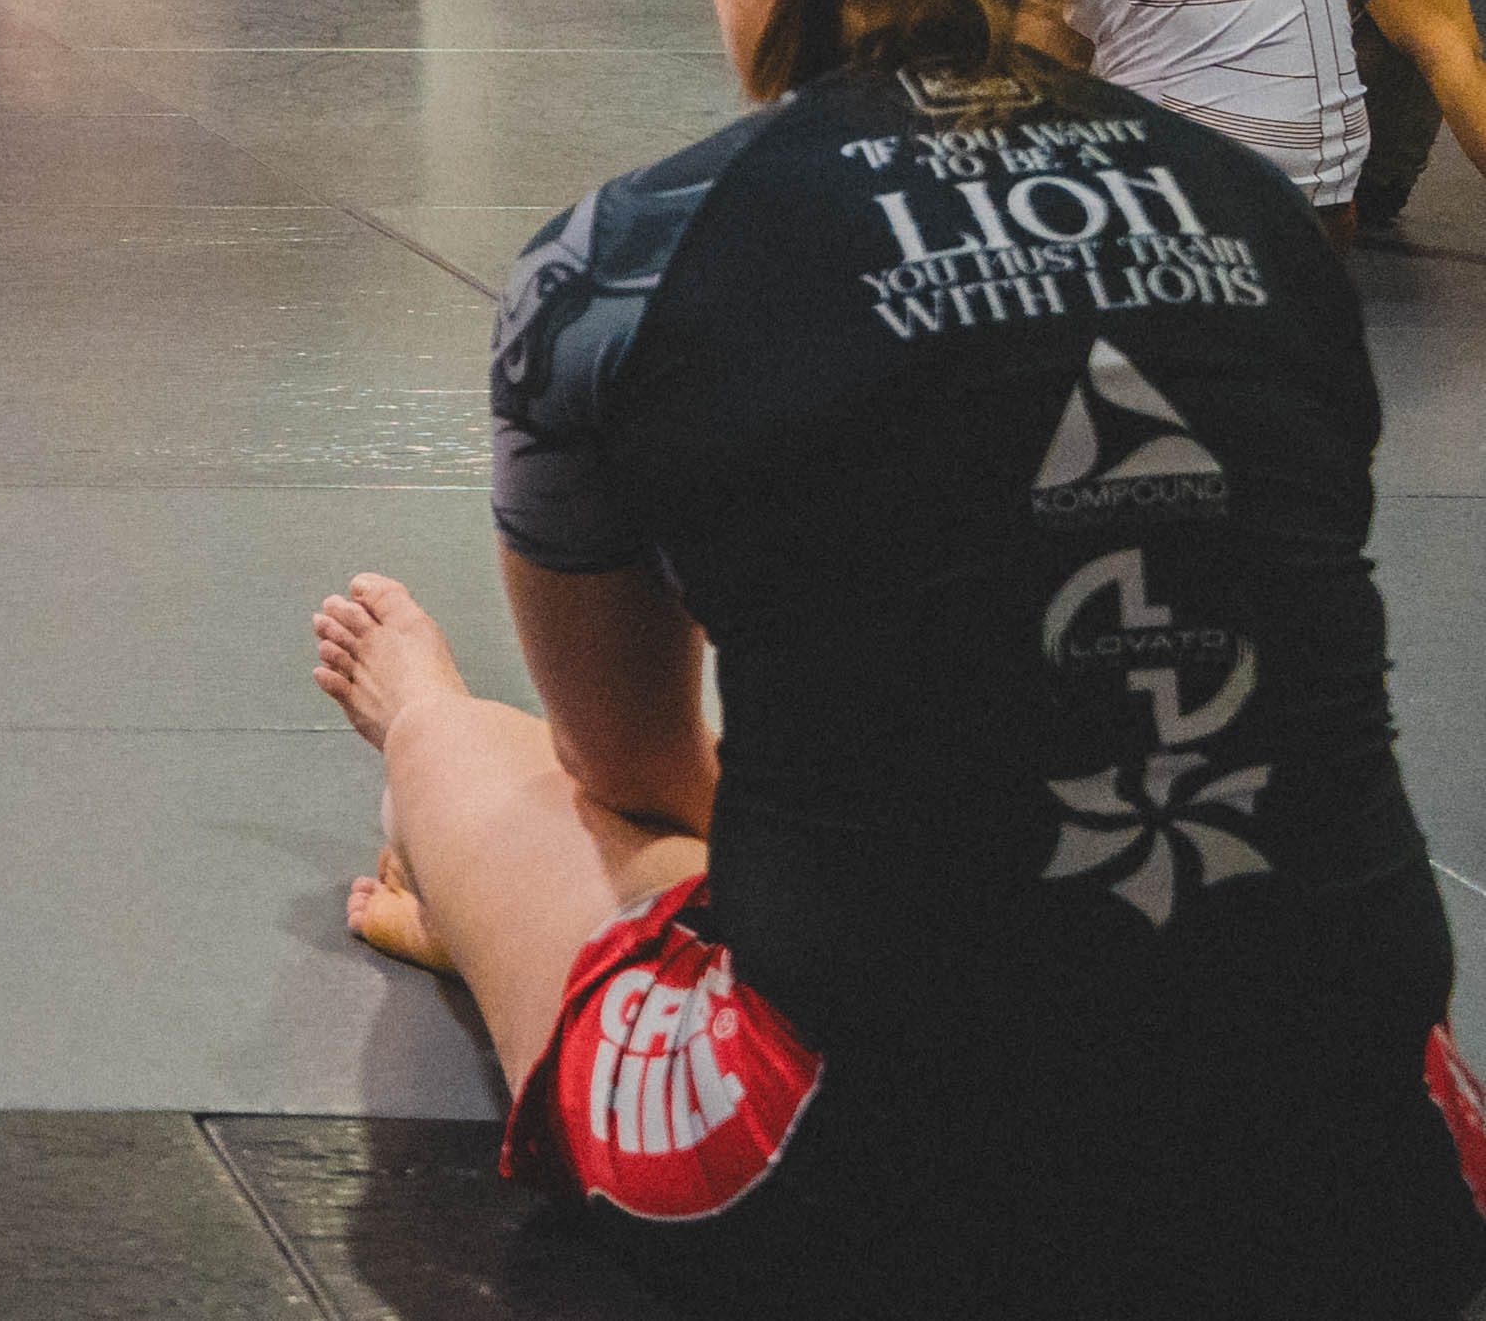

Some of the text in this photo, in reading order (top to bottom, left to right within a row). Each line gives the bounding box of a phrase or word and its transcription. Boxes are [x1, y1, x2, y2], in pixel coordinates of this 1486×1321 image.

[914, 152, 986, 180] TO
[1076, 142, 1113, 168] A
[915, 126, 1009, 157] YOU
[872, 165, 1206, 264] LION
[859, 256, 960, 301] YOU
[872, 263, 1270, 340] WITH LIONS
